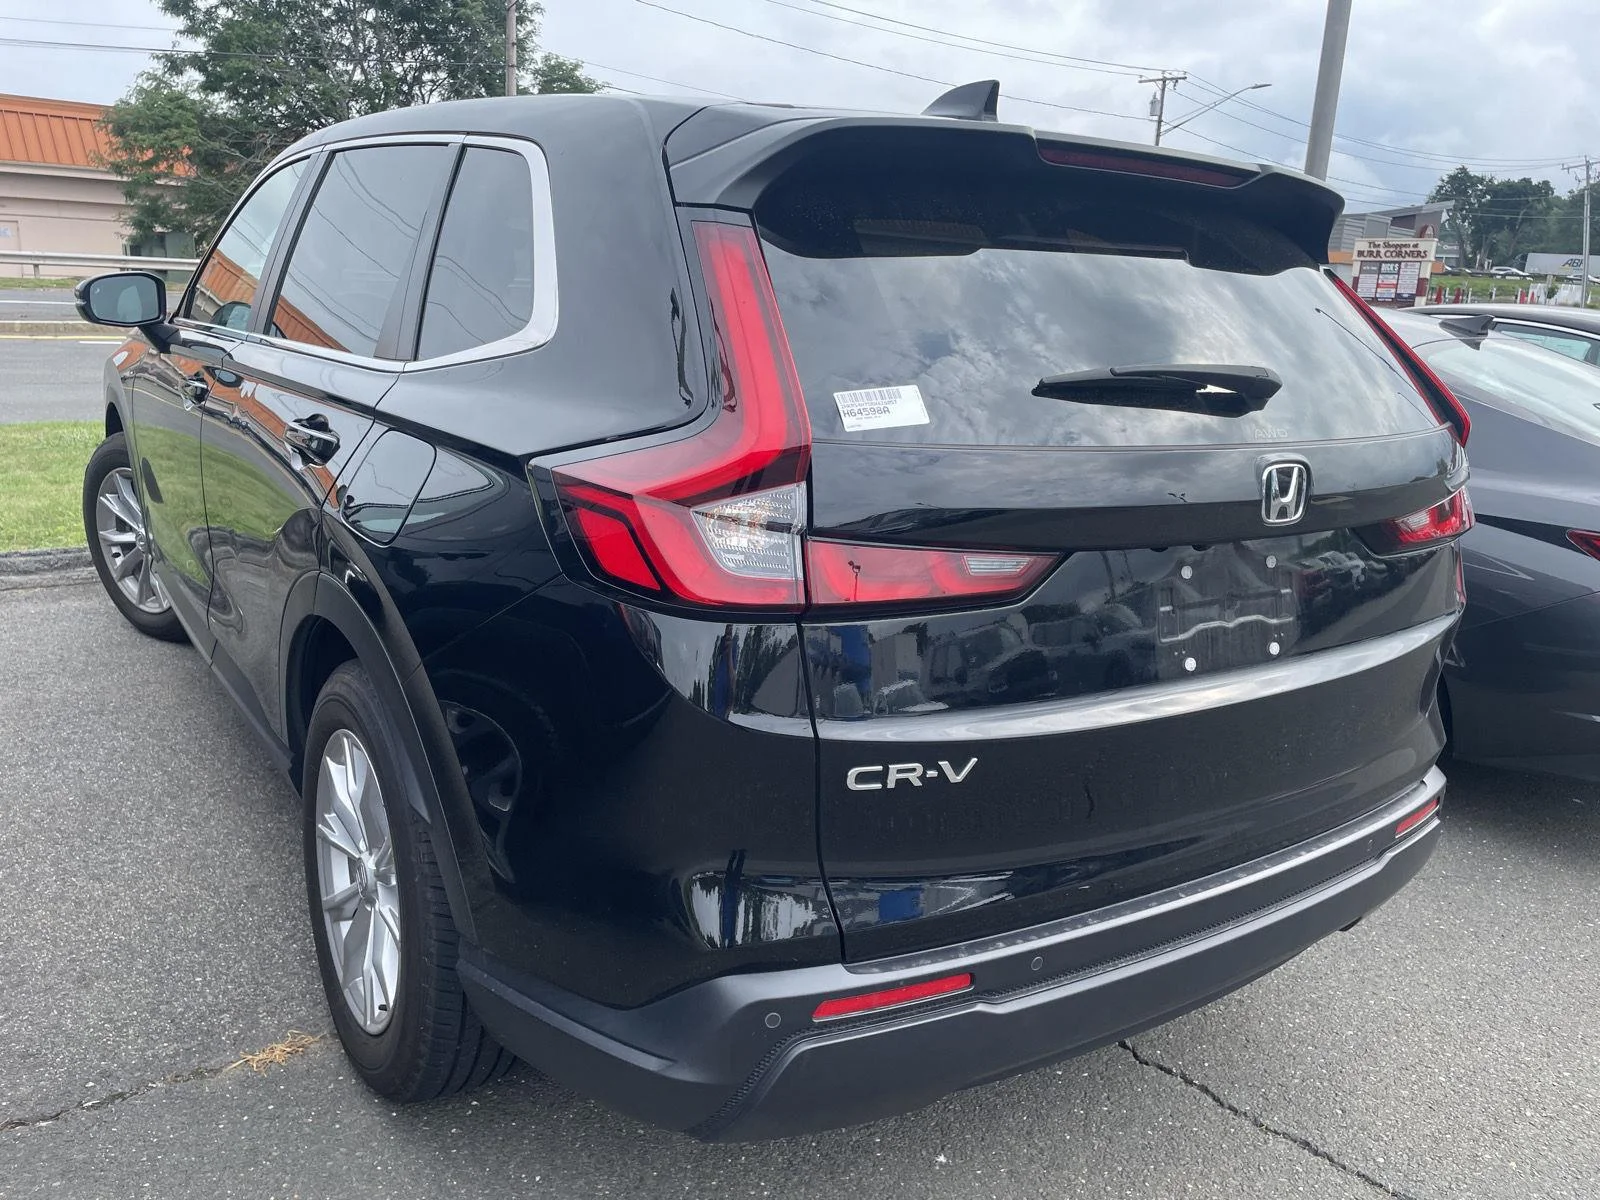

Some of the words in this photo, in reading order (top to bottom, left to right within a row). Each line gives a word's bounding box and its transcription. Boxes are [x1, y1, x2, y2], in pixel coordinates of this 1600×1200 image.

[1368, 241, 1381, 249] The
[1383, 241, 1411, 250] Shoppes
[1357, 249, 1382, 259] BURR
[1384, 249, 1428, 259] CORNERS
[842, 405, 891, 418] H64598A
[1254, 428, 1288, 440] AWD
[846, 757, 978, 791] CR-V
